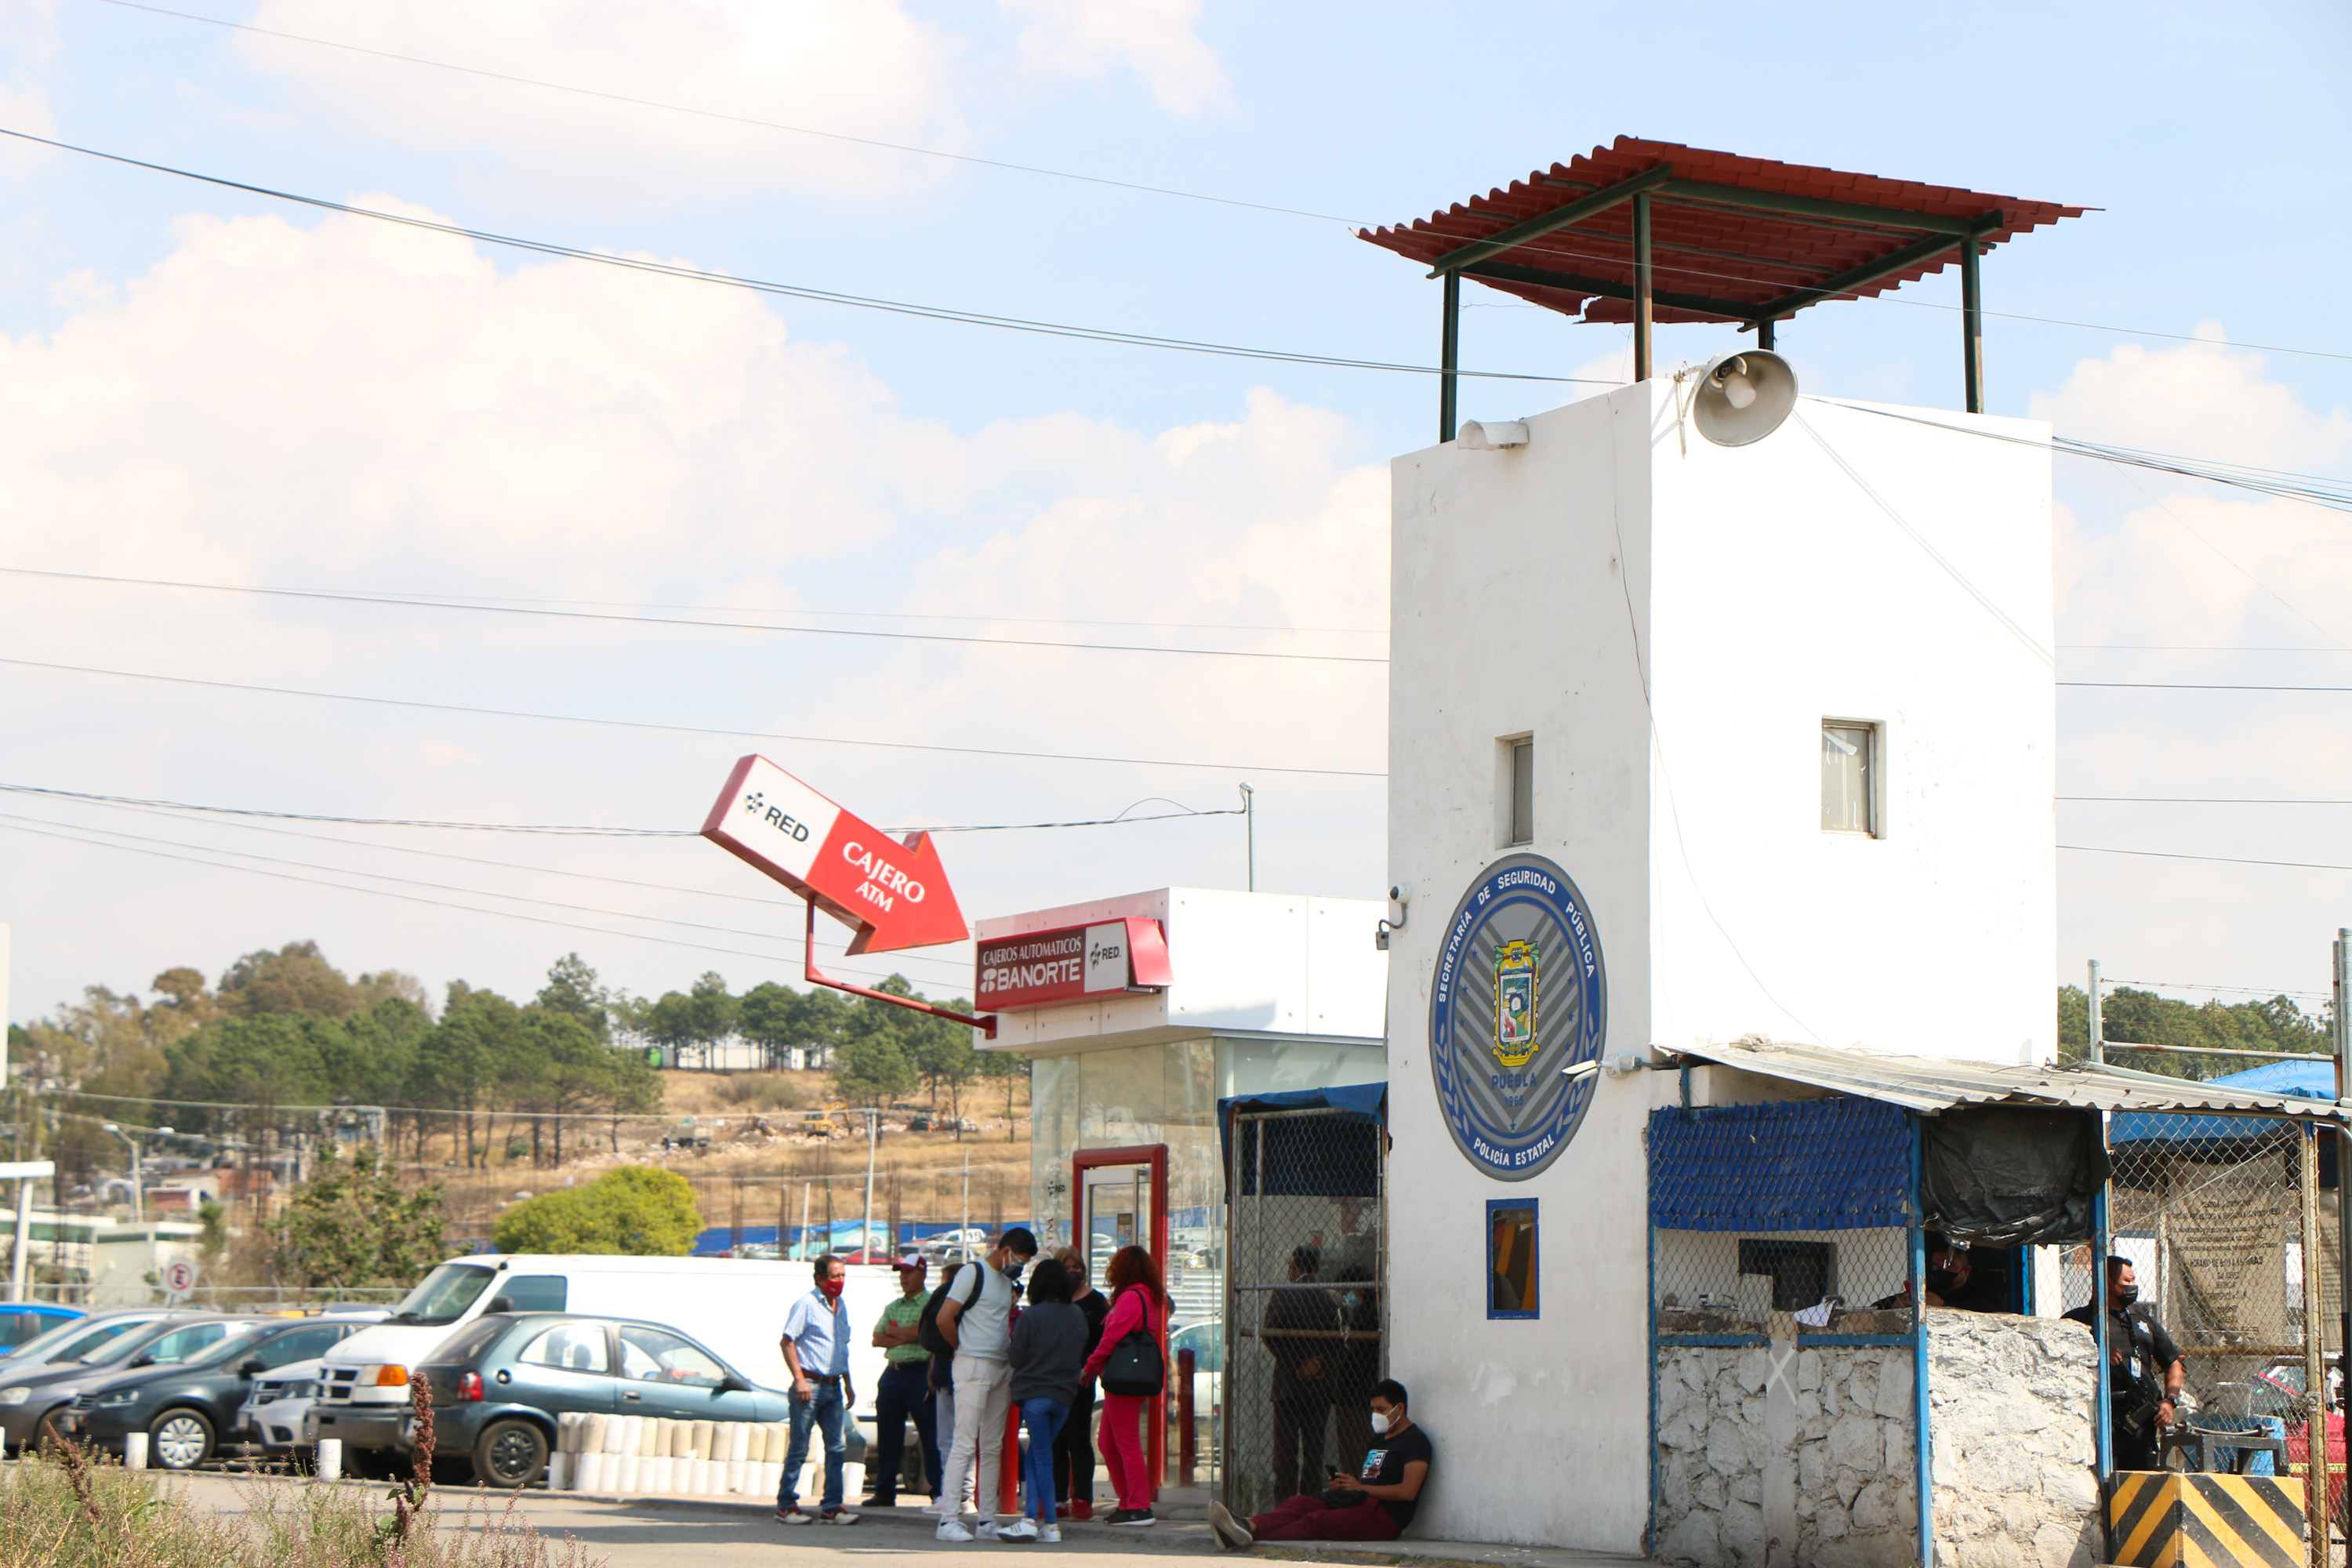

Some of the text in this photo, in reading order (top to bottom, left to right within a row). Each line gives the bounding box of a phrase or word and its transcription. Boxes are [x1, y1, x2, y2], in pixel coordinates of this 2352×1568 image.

[764, 805, 809, 842] RED
[843, 841, 925, 902] CAJERO
[855, 880, 894, 913] ATM
[982, 936, 1083, 967] CAJEROS AUTOMATICOS
[1102, 946, 1120, 960] RED
[1439, 870, 1595, 1003] SECRETARÍA DE SEGURIDAD PÚBLICA
[997, 957, 1082, 992] BANORTE
[1491, 1072, 1537, 1090] PUEBLA
[1474, 1134, 1555, 1166] POLICÍA ESTATAL
